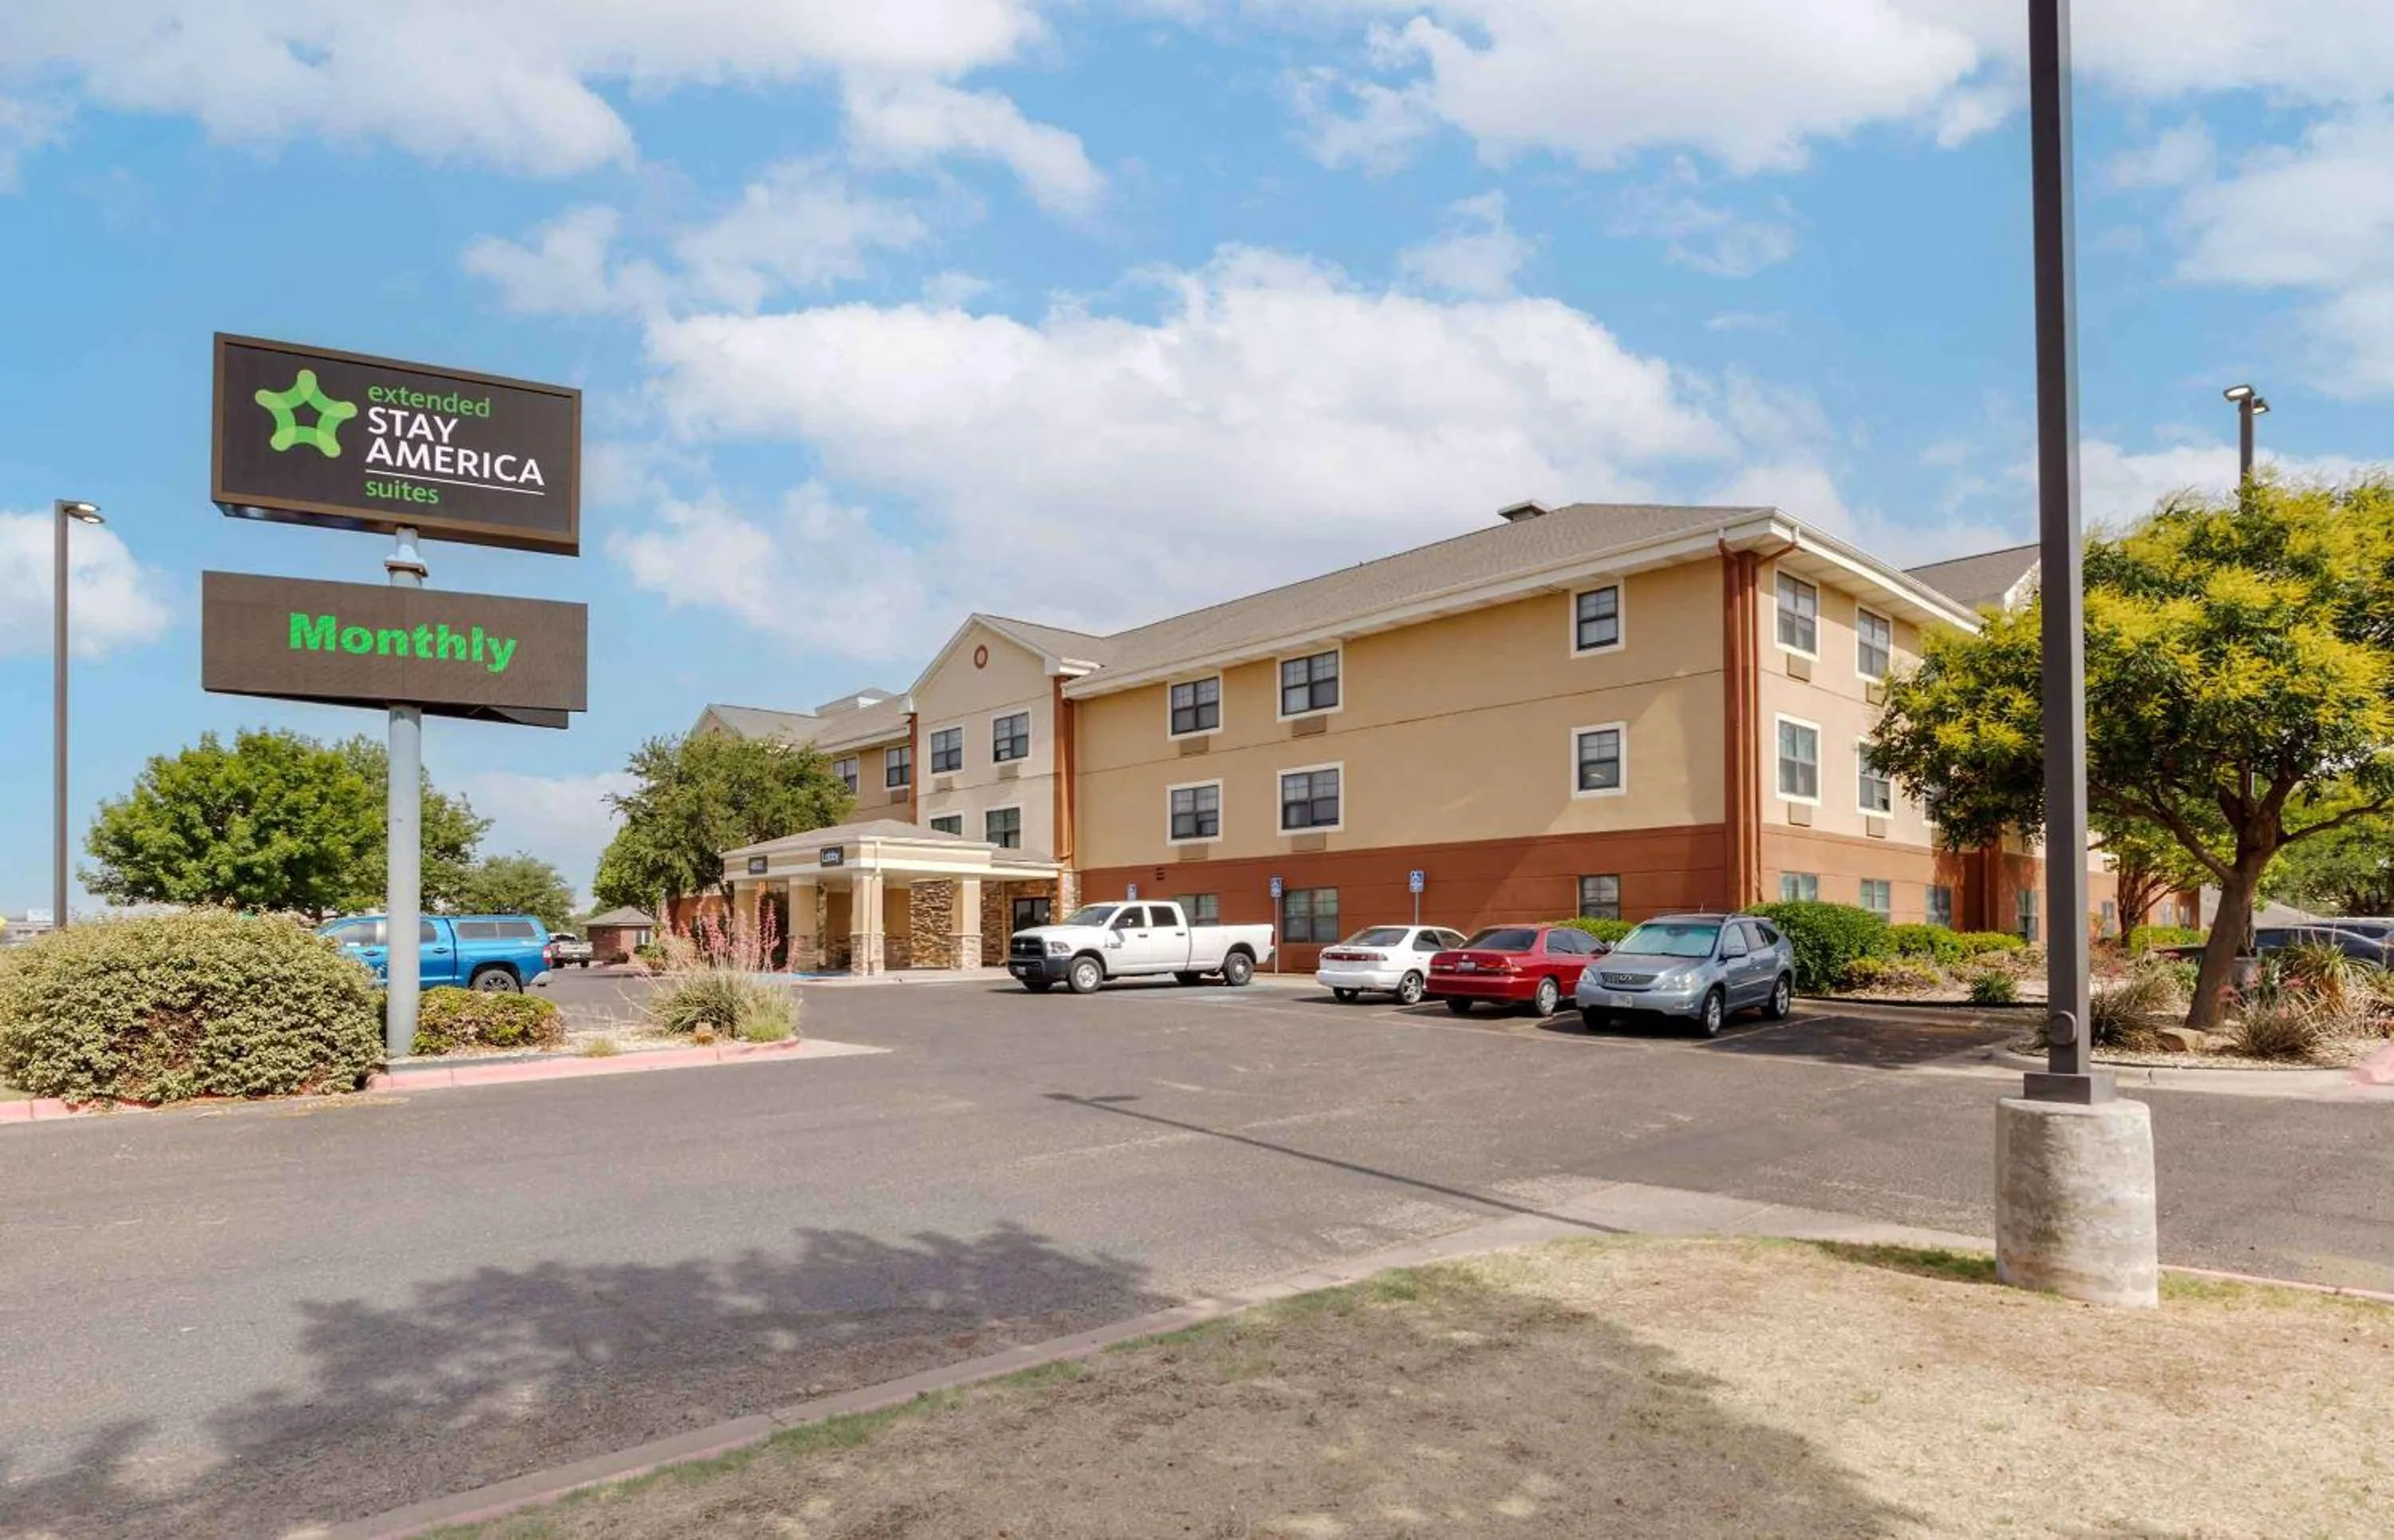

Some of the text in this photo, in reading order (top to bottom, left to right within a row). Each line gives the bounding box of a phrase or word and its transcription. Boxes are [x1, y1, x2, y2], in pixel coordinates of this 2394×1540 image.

[368, 385, 491, 418] extended
[368, 406, 459, 443] STAY
[365, 436, 545, 486] AMERICA
[365, 481, 439, 504] suites
[288, 612, 517, 673] Monthly
